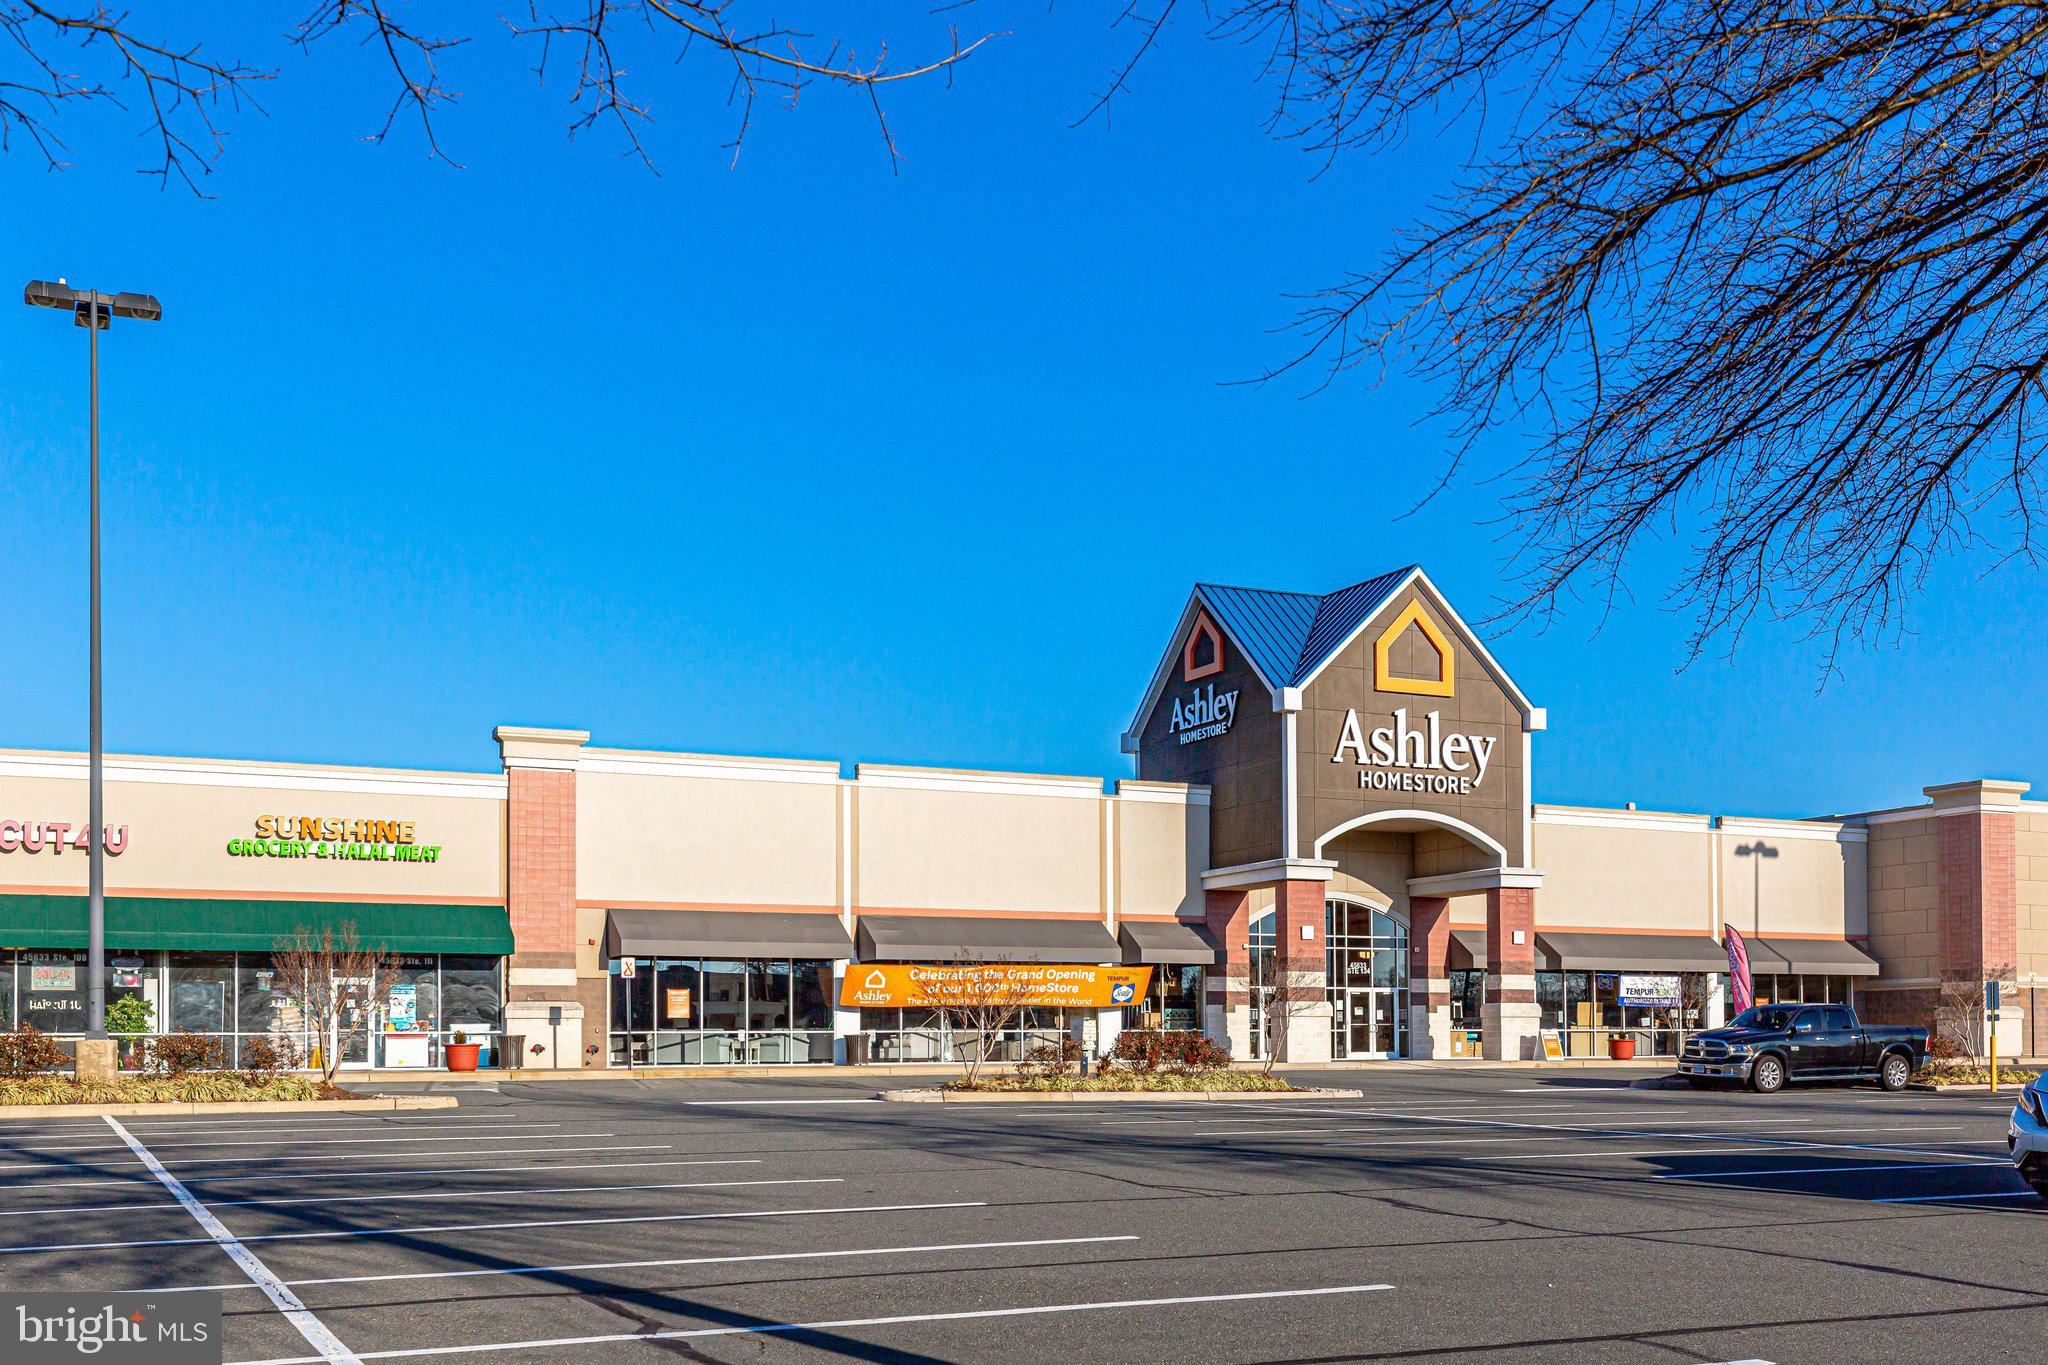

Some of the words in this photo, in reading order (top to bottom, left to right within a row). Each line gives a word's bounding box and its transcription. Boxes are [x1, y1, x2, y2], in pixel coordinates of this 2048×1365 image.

[1169, 683, 1239, 734] Ashley
[1180, 721, 1227, 745] HOMESTORE
[1332, 708, 1496, 787] Ashley
[1358, 769, 1471, 795] HOMESTORE
[256, 814, 416, 843] SUNSHINE
[228, 838, 313, 858] GROCERY
[317, 841, 329, 857] &
[335, 842, 391, 861] HALAL
[394, 844, 441, 863] MEAT
[909, 968, 982, 983] Celebrating
[984, 968, 1005, 980] the
[1007, 968, 1044, 980] Grand
[1046, 968, 1096, 983] Opening
[854, 989, 892, 1004] Ashley
[927, 982, 941, 994] of
[1011, 982, 1079, 993] HomeStore
[1625, 987, 1654, 996] TEMPUR
[1069, 997, 1093, 1006] World
